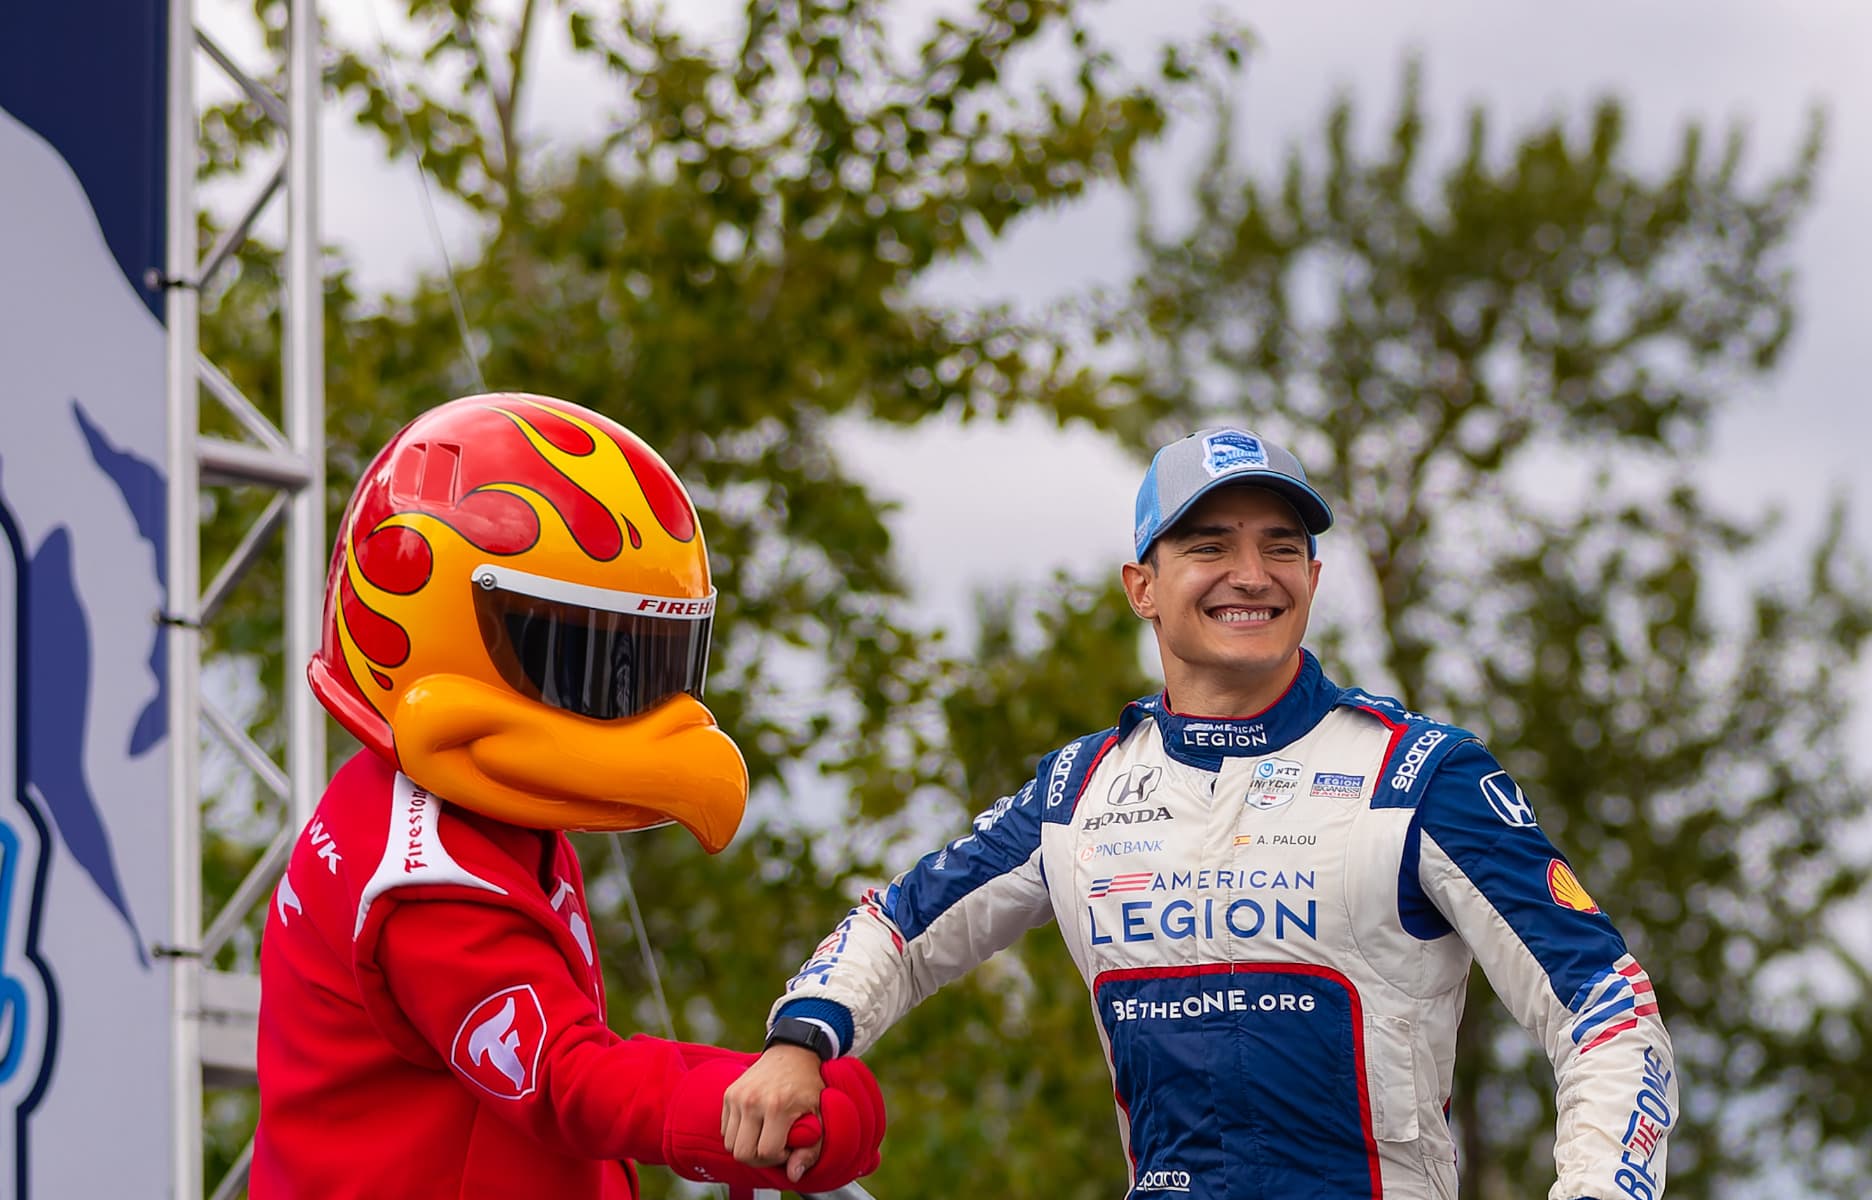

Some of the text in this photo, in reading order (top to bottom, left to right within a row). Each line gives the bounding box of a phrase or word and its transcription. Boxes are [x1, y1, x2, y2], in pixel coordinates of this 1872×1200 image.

[1183, 731, 1267, 747] LEGION
[1207, 723, 1264, 734] AMERICAN
[1276, 767, 1300, 776] NTT
[1391, 730, 1447, 792] sparco
[1048, 742, 1082, 808] sparco
[1317, 778, 1361, 787] LEGION
[403, 784, 429, 873] Fireston
[1082, 806, 1174, 831] HONDA
[1256, 834, 1317, 846] A. PALOU
[1151, 871, 1315, 892] AMERICAN
[1088, 898, 1317, 946] LEGION
